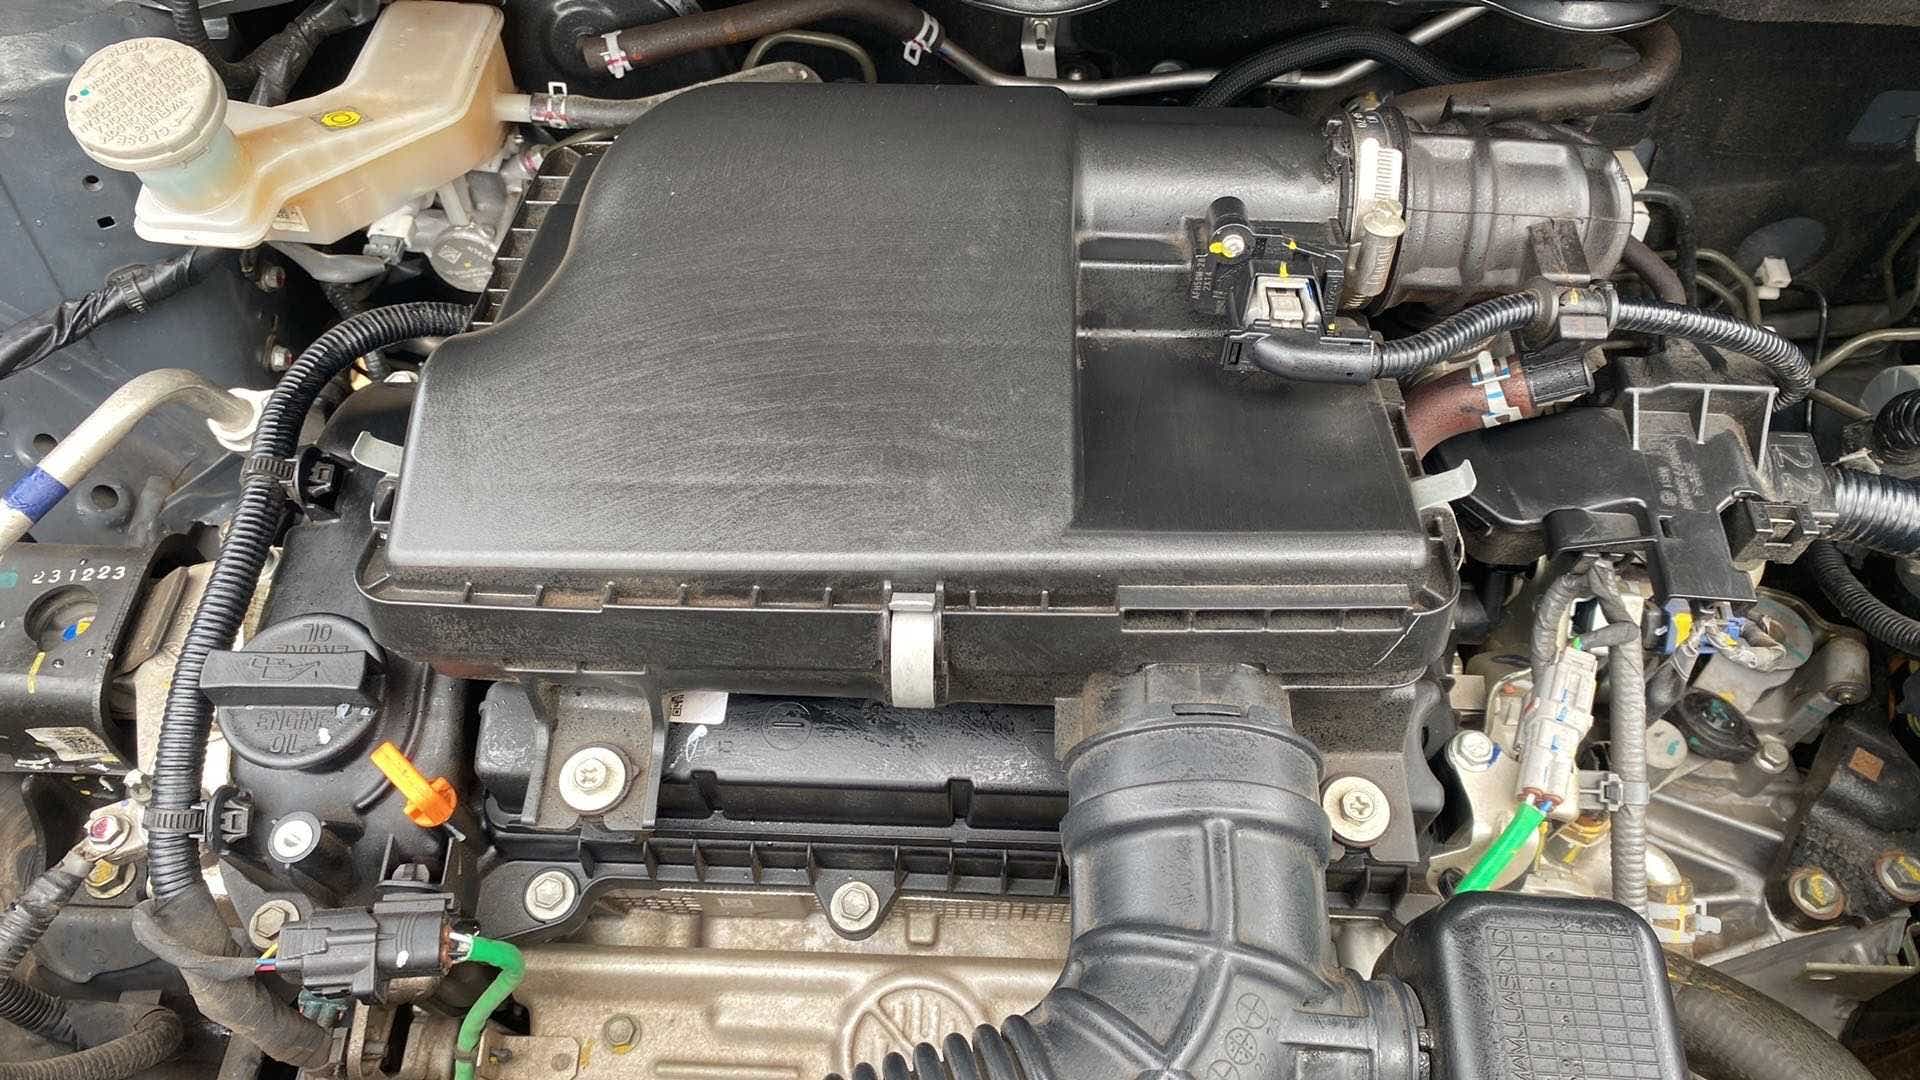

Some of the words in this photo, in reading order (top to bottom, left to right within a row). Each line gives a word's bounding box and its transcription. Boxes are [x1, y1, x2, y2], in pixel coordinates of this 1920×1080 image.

[32, 565, 126, 584] 231223
[302, 623, 333, 642] OIL
[256, 710, 331, 731] ENGINE
[269, 733, 305, 755] OIL
